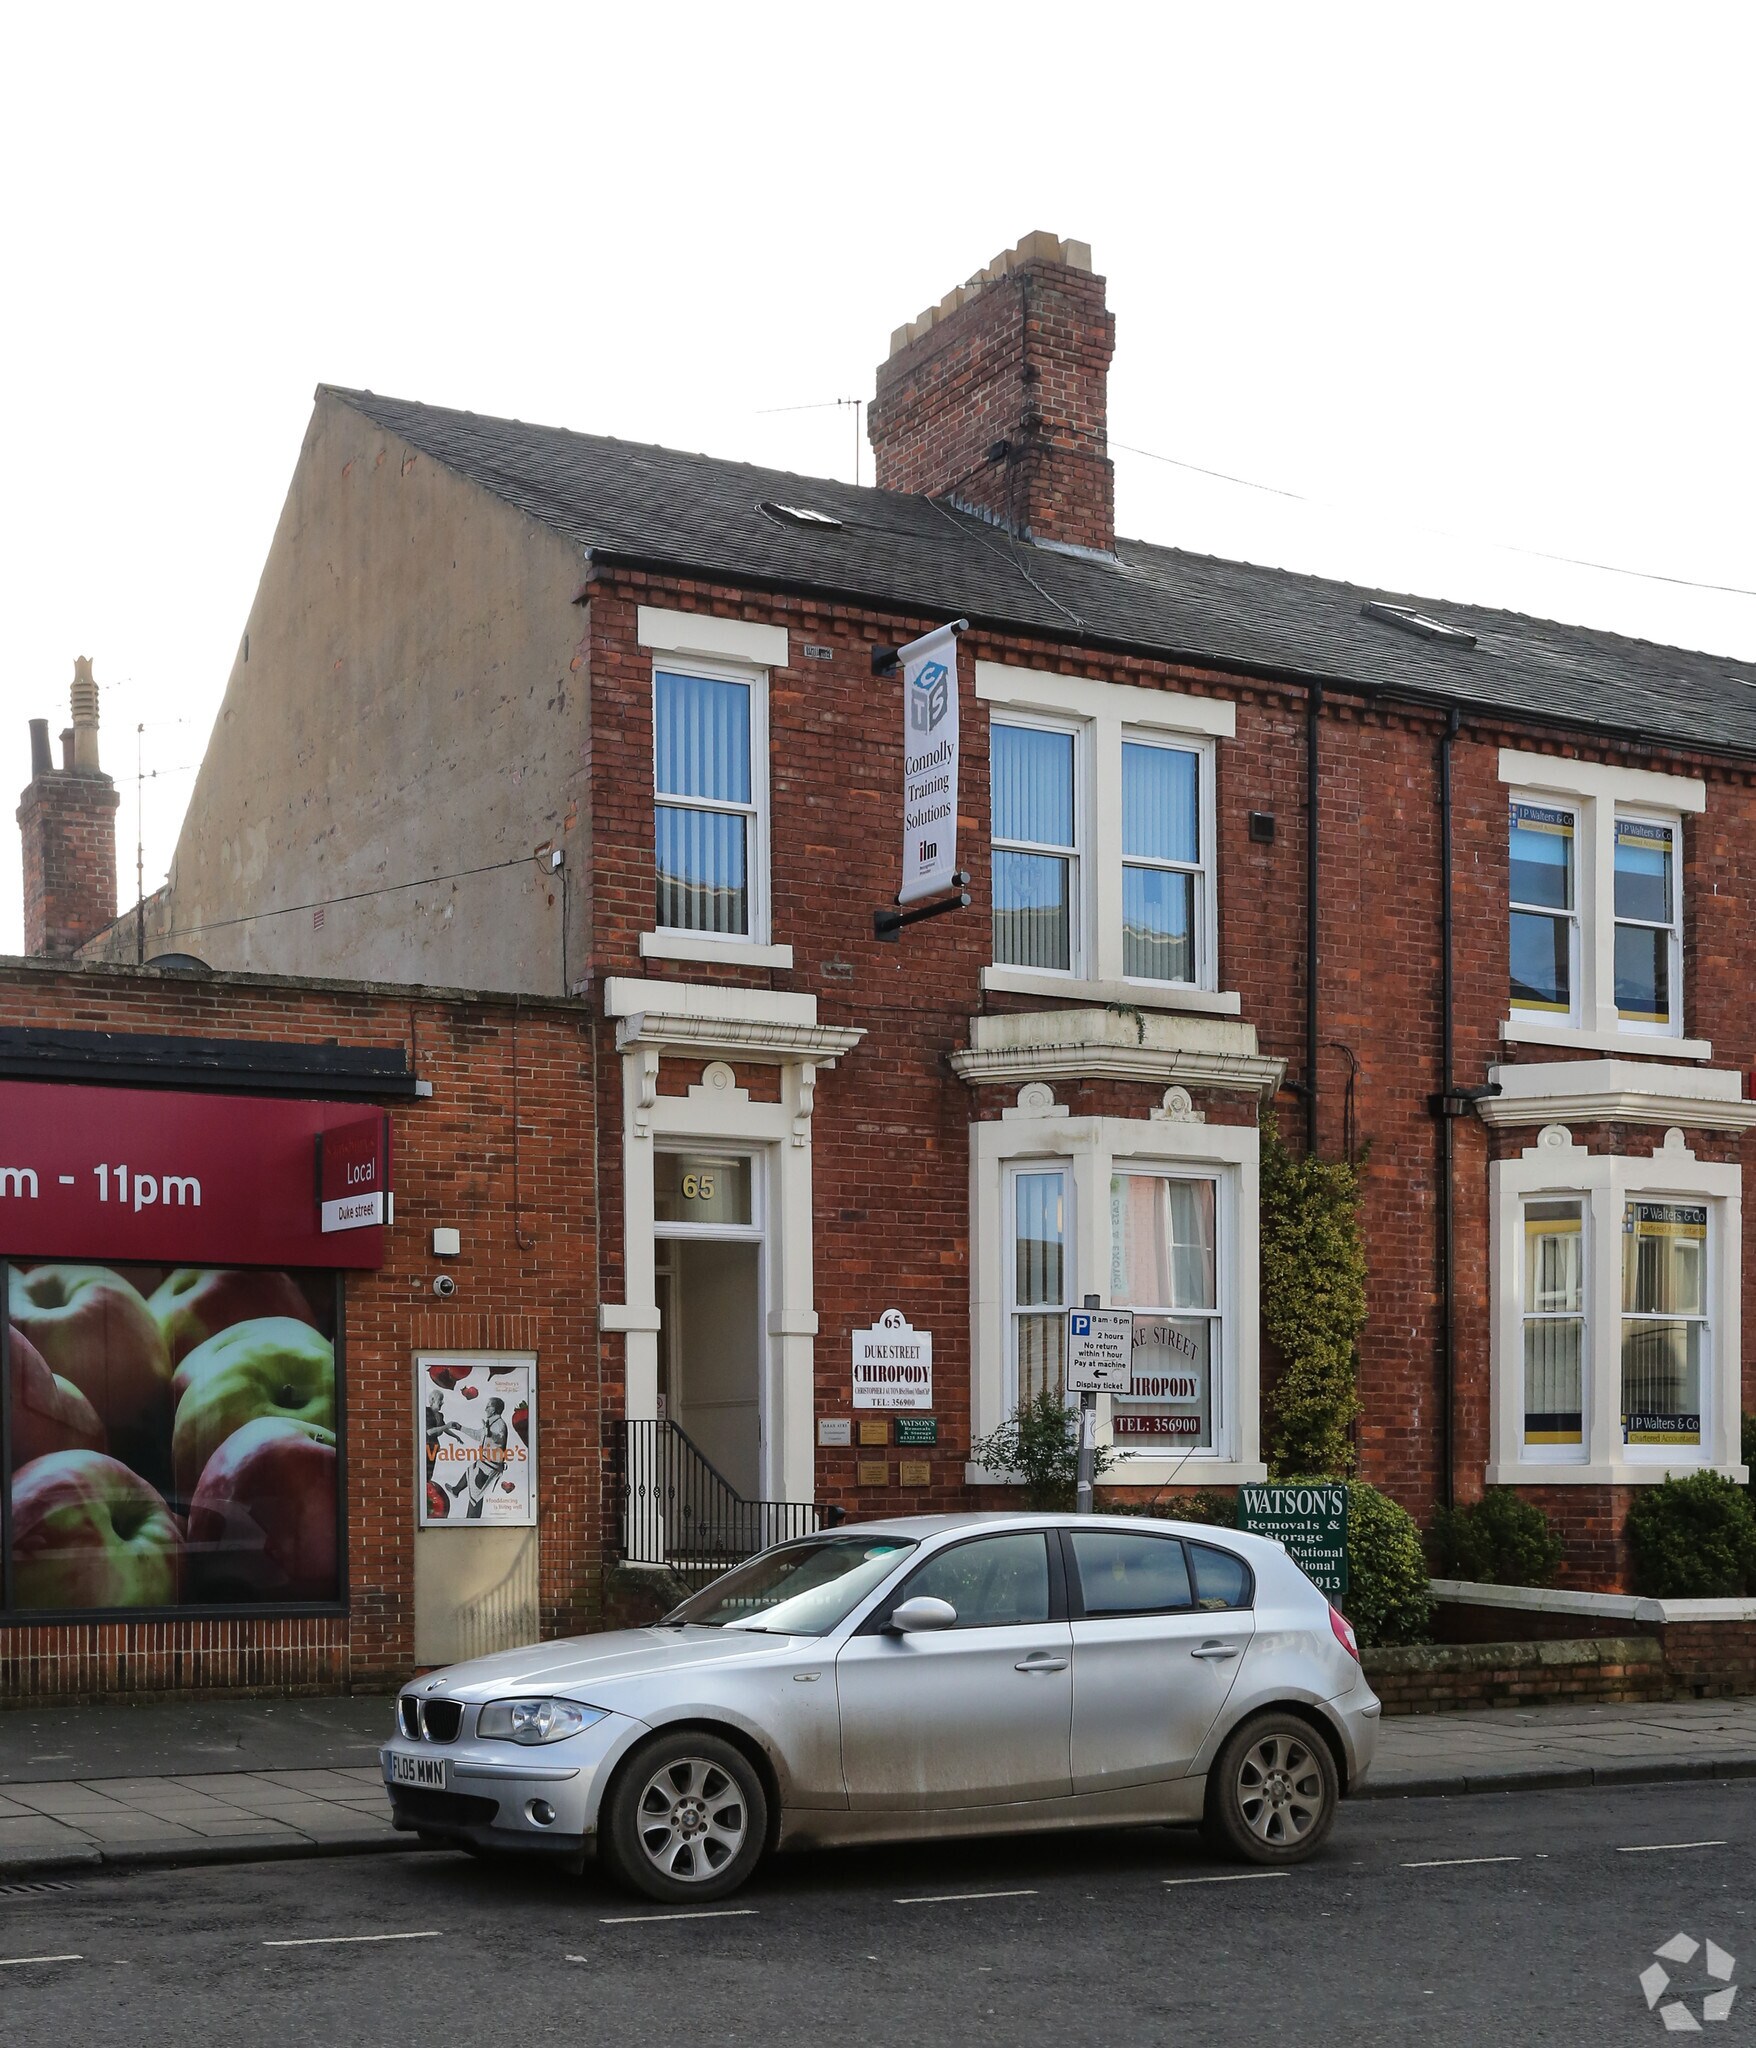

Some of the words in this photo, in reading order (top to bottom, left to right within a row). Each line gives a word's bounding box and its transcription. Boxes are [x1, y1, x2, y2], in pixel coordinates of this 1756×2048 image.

[905, 739, 954, 775] Connolly
[908, 775, 949, 802] Training
[906, 802, 951, 831] Solutions
[1530, 809, 1554, 823] Walters
[1556, 813, 1562, 824] &
[1563, 815, 1573, 825] Co
[1630, 824, 1654, 838] Walters
[1655, 829, 1661, 838] &
[1662, 831, 1671, 840] Co
[920, 840, 937, 863] ilm
[347, 1157, 375, 1185] Local
[58, 1175, 75, 1184] -
[93, 1163, 201, 1213] 11pm
[682, 1174, 715, 1199] 65
[338, 1206, 353, 1220] Duke
[354, 1201, 374, 1217] street
[1642, 1207, 1648, 1219] P
[1650, 1207, 1681, 1221] Walters
[1684, 1209, 1691, 1221] &
[1693, 1210, 1705, 1222] Co
[884, 1315, 901, 1329] 65
[1076, 1317, 1088, 1334] P
[1153, 1326, 1199, 1361] STREET
[864, 1345, 888, 1358] DUKE
[889, 1345, 921, 1359] STREET
[1074, 1359, 1086, 1367] Pay
[1098, 1361, 1126, 1369] machine
[854, 1364, 930, 1383] CHIROPODY
[1076, 1381, 1101, 1389] Display
[1103, 1382, 1123, 1390] ticket
[872, 1398, 890, 1406] TEL:
[891, 1398, 915, 1407] 356900
[1117, 1417, 1150, 1432] TEL:
[1153, 1418, 1197, 1432] 356900
[1636, 1417, 1642, 1429] P
[1643, 1416, 1675, 1430] Walters
[1678, 1417, 1685, 1430] &
[1686, 1418, 1698, 1430] Co
[1630, 1434, 1660, 1443] Chartered
[1661, 1434, 1698, 1444] Accountants
[426, 1443, 527, 1462] Valentine's
[1243, 1489, 1343, 1516] WATSON'S
[1247, 1520, 1320, 1530] Removals
[1327, 1520, 1340, 1530] &
[1264, 1532, 1323, 1544] Storage
[1291, 1547, 1343, 1557] National
[393, 1755, 415, 1781] FL05
[417, 1759, 443, 1784] MWN
